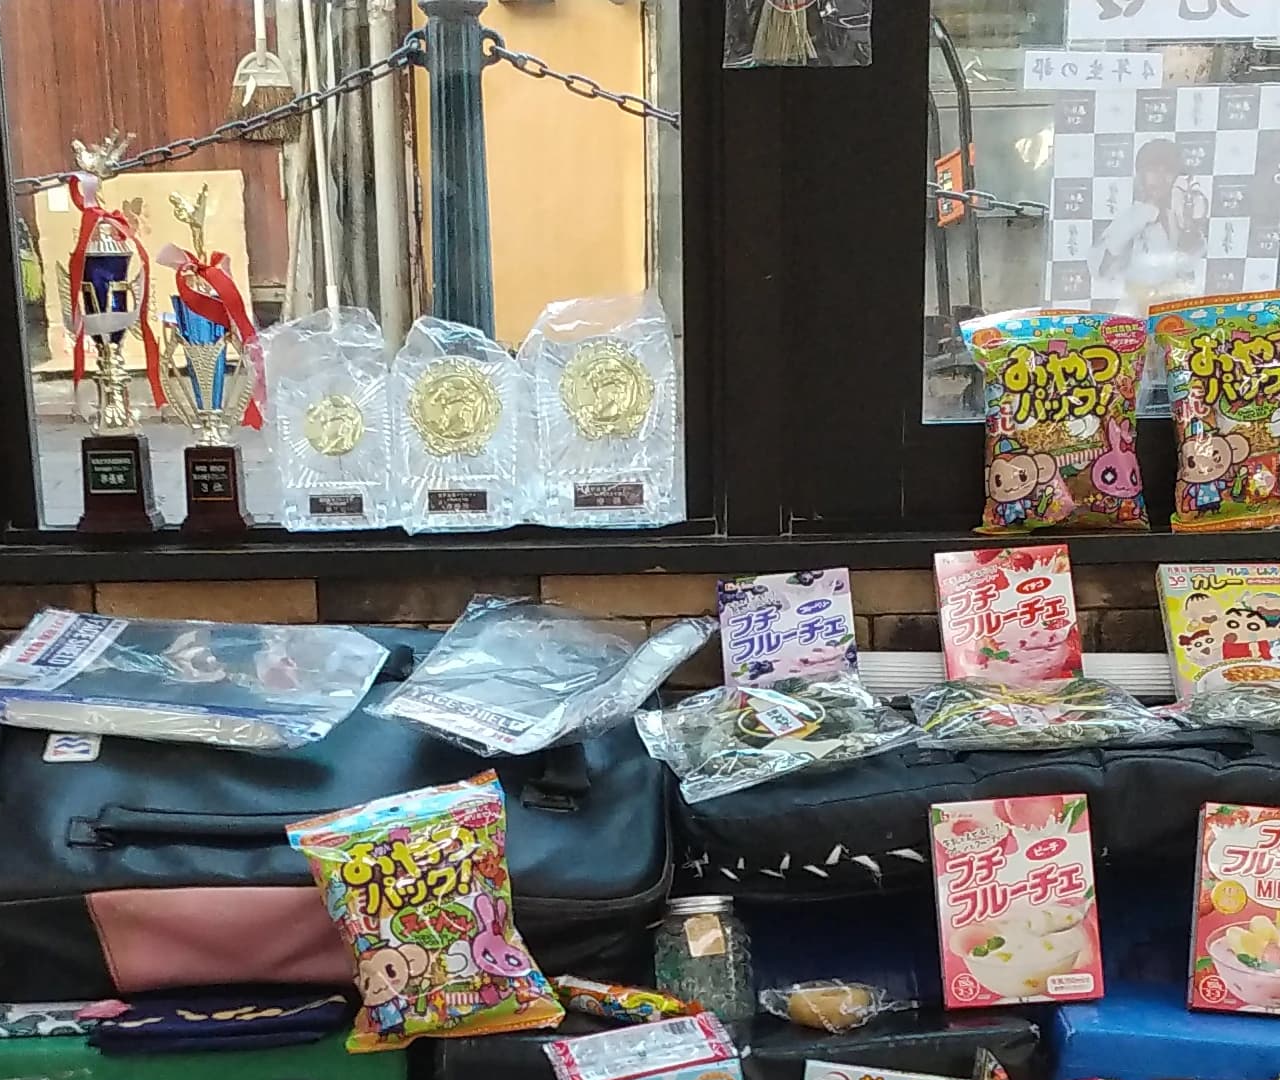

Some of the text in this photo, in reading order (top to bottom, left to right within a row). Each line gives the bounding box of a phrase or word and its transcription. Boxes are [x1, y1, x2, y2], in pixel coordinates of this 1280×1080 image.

[1004, 344, 1120, 392] おやつ
[1015, 384, 1112, 423] パック!
[948, 585, 998, 618] プチ
[1191, 574, 1244, 591] カレー
[730, 608, 778, 638] プチ
[732, 617, 846, 664] フルーチェ
[951, 598, 1065, 645] フルーチェ
[342, 826, 475, 885] おやつ
[947, 848, 1006, 891] プチ
[1032, 842, 1060, 857] ピーチ
[368, 857, 472, 915] パック!
[949, 863, 1086, 930] フルーチェ
